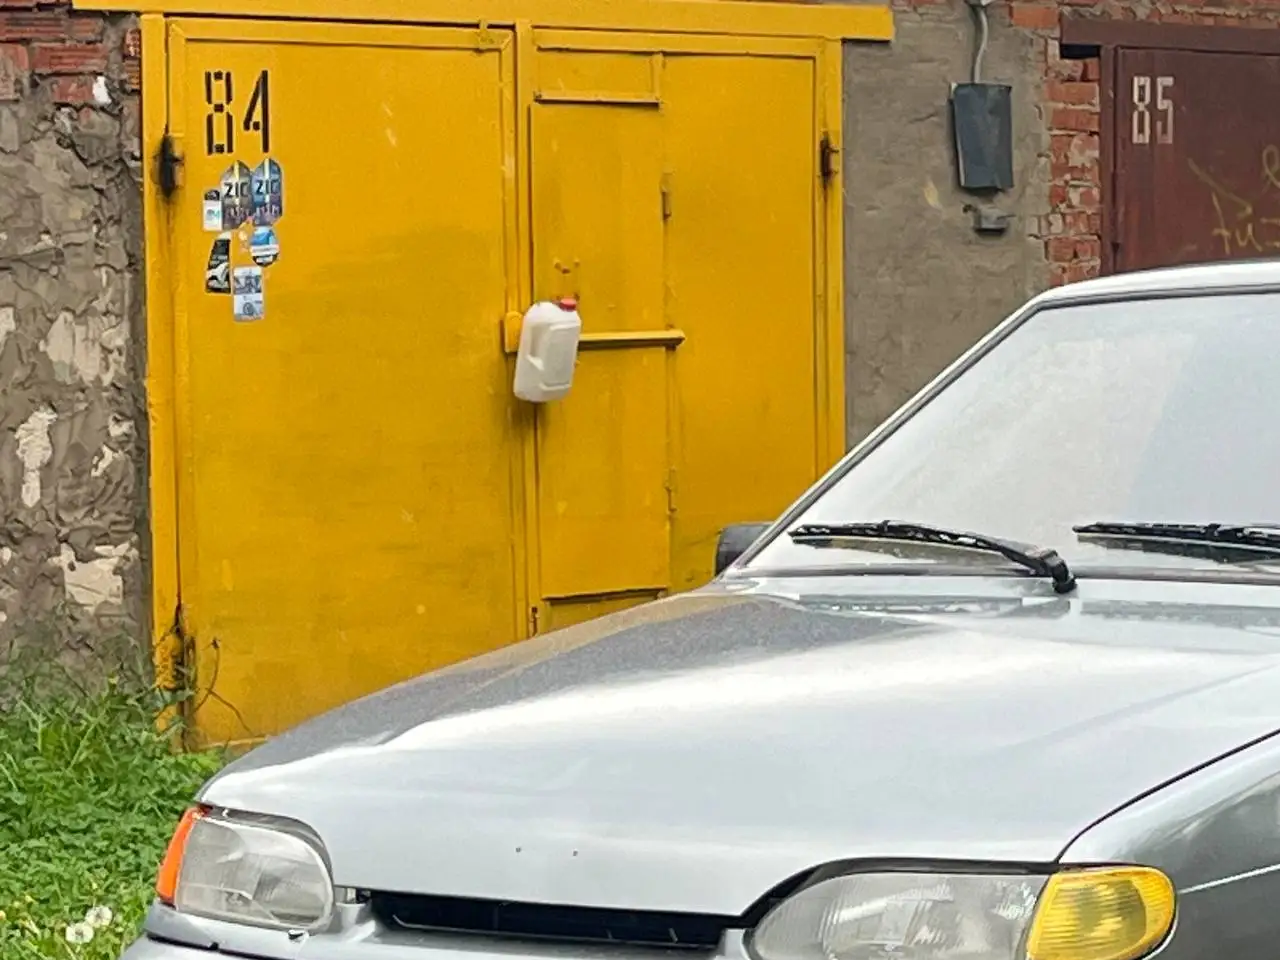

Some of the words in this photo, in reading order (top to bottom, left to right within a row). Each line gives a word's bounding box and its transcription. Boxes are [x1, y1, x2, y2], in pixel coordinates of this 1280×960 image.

[205, 70, 268, 156] 84
[1132, 76, 1174, 144] 85
[223, 181, 249, 198] ZIC
